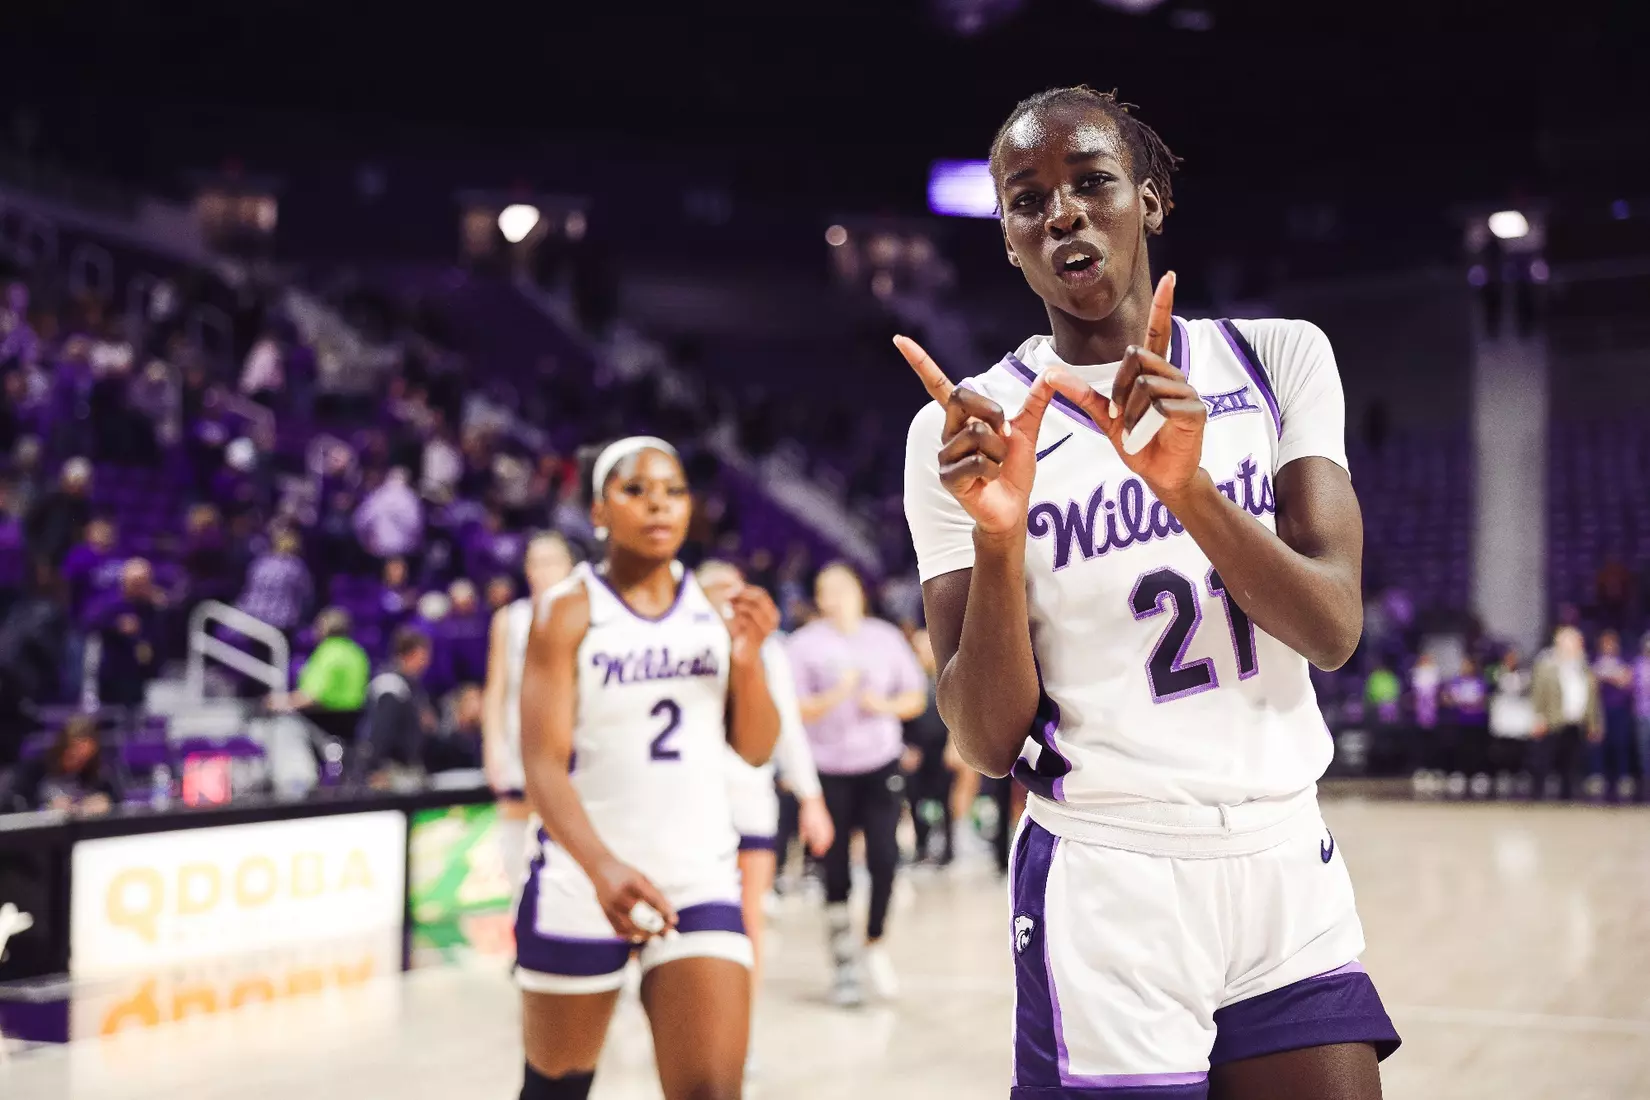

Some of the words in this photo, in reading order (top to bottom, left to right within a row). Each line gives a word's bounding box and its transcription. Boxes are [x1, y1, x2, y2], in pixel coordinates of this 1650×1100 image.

[1199, 384, 1259, 418] XII
[1027, 454, 1275, 572] Wildats
[1128, 565, 1259, 703] 21
[650, 699, 681, 760] 2
